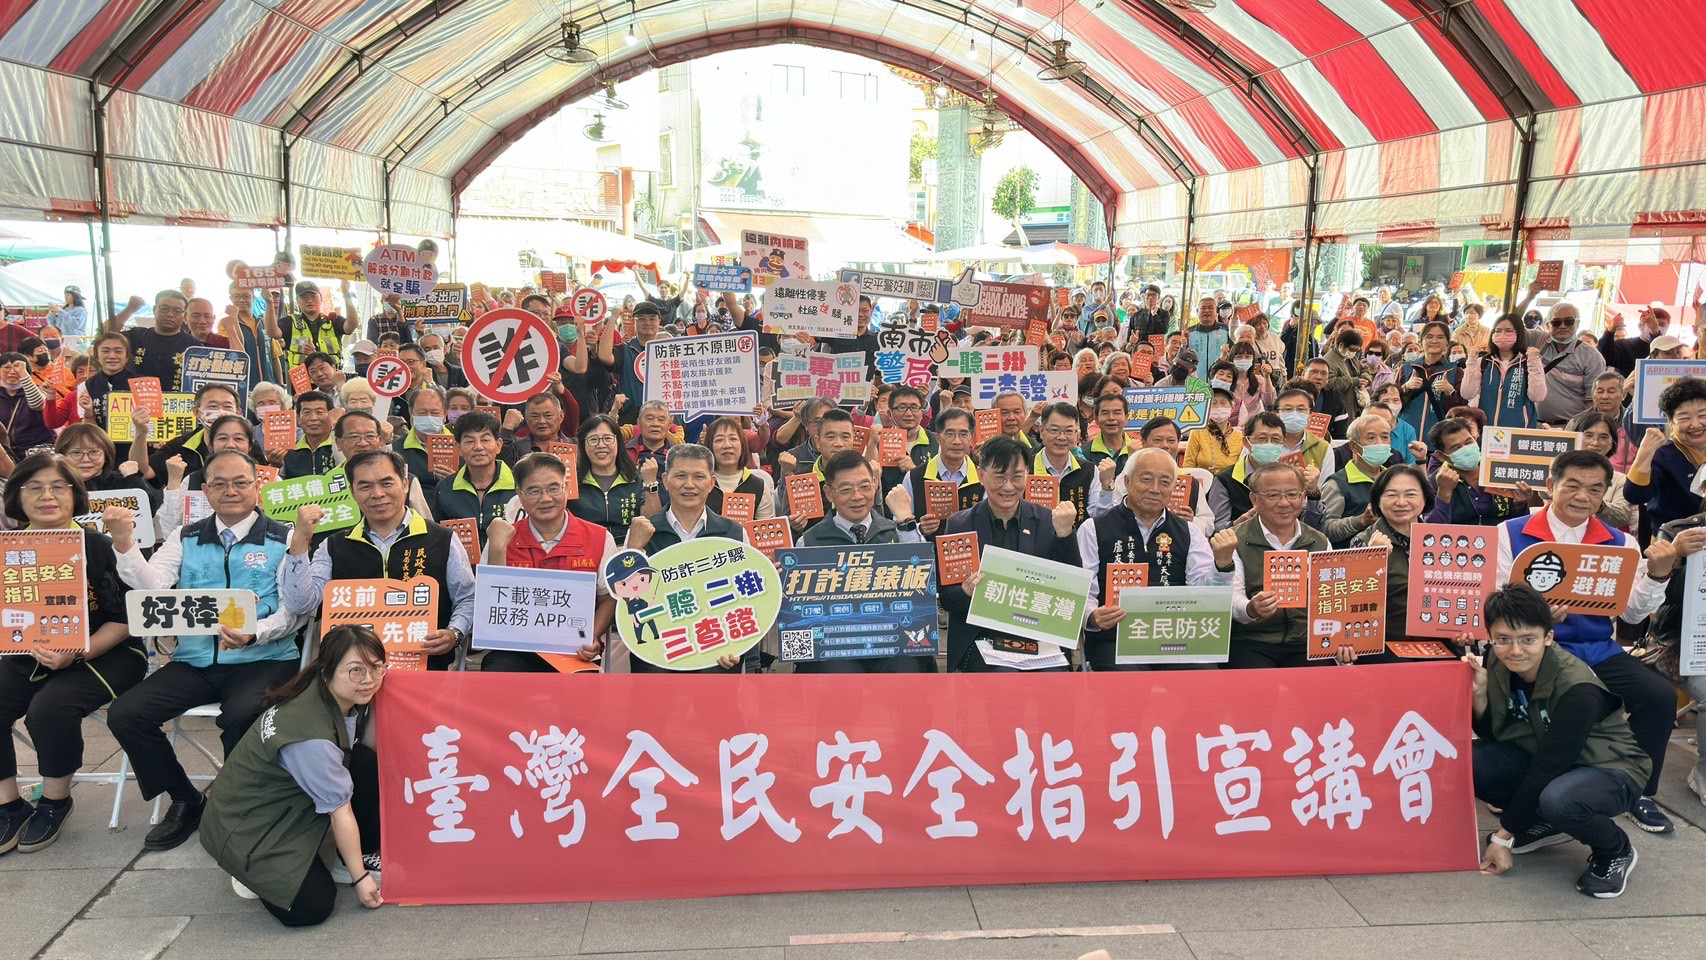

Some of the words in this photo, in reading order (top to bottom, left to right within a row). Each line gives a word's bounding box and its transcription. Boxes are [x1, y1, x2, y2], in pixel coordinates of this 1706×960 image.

[380, 248, 416, 263] ATM
[243, 268, 275, 278] 165
[367, 262, 433, 281] 解除分期付款
[380, 278, 420, 296] 就是騙
[774, 287, 827, 302] 遠離性侵害
[1002, 293, 1027, 308] GANG
[655, 338, 737, 359] 防詐五不原則
[835, 356, 861, 369] 165
[1517, 439, 1568, 454] 響起警報
[1494, 466, 1545, 481] 避難防爆
[266, 479, 325, 506] 有準備
[5, 549, 37, 566] 臺灣
[661, 546, 747, 584] 防詐三步驟
[837, 550, 876, 568] 165
[1577, 553, 1624, 575] 正確
[2, 563, 77, 585] 全民安全
[785, 563, 932, 596] 打詐儀錶板
[1318, 566, 1347, 582] 臺灣
[1423, 569, 1483, 582] 當危機來臨時
[4, 585, 40, 605] 指引
[1317, 576, 1380, 599] 全民安全
[1571, 575, 1618, 597] 避難
[330, 585, 378, 609] 災前
[489, 585, 573, 609] 下載警政
[983, 579, 1077, 622] 韌性臺灣
[1317, 597, 1348, 615] 指引
[140, 595, 220, 629] 好棒
[488, 605, 530, 628] 服務
[534, 611, 568, 628] APP
[382, 620, 430, 644] 先備
[661, 606, 760, 661] 三查證
[1127, 616, 1222, 640] 全民防災
[404, 709, 1458, 848] 臺灣全民安全指引宣講會
